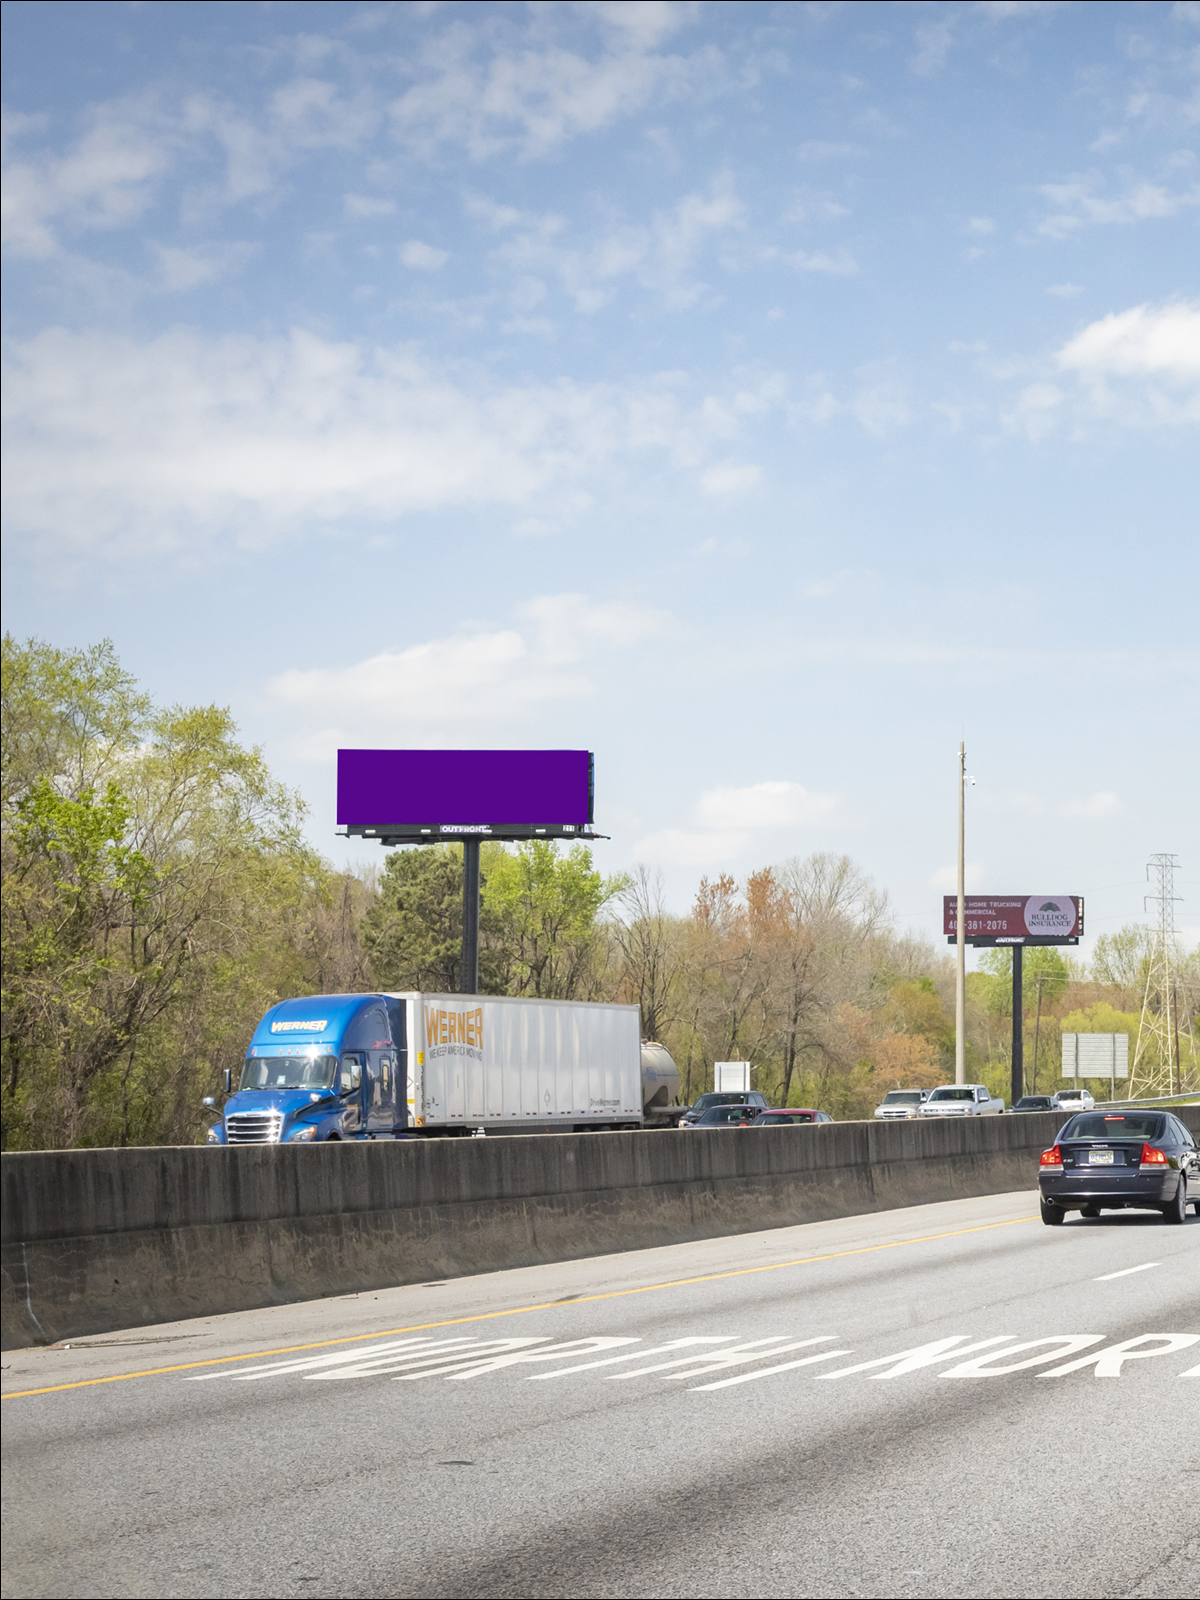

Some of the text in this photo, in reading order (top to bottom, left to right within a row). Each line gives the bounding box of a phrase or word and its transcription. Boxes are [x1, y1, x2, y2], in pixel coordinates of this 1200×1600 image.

[948, 920, 1007, 930] 40-361-2075
[271, 1020, 327, 1032] WERNER
[424, 1006, 483, 1049] WERNER
